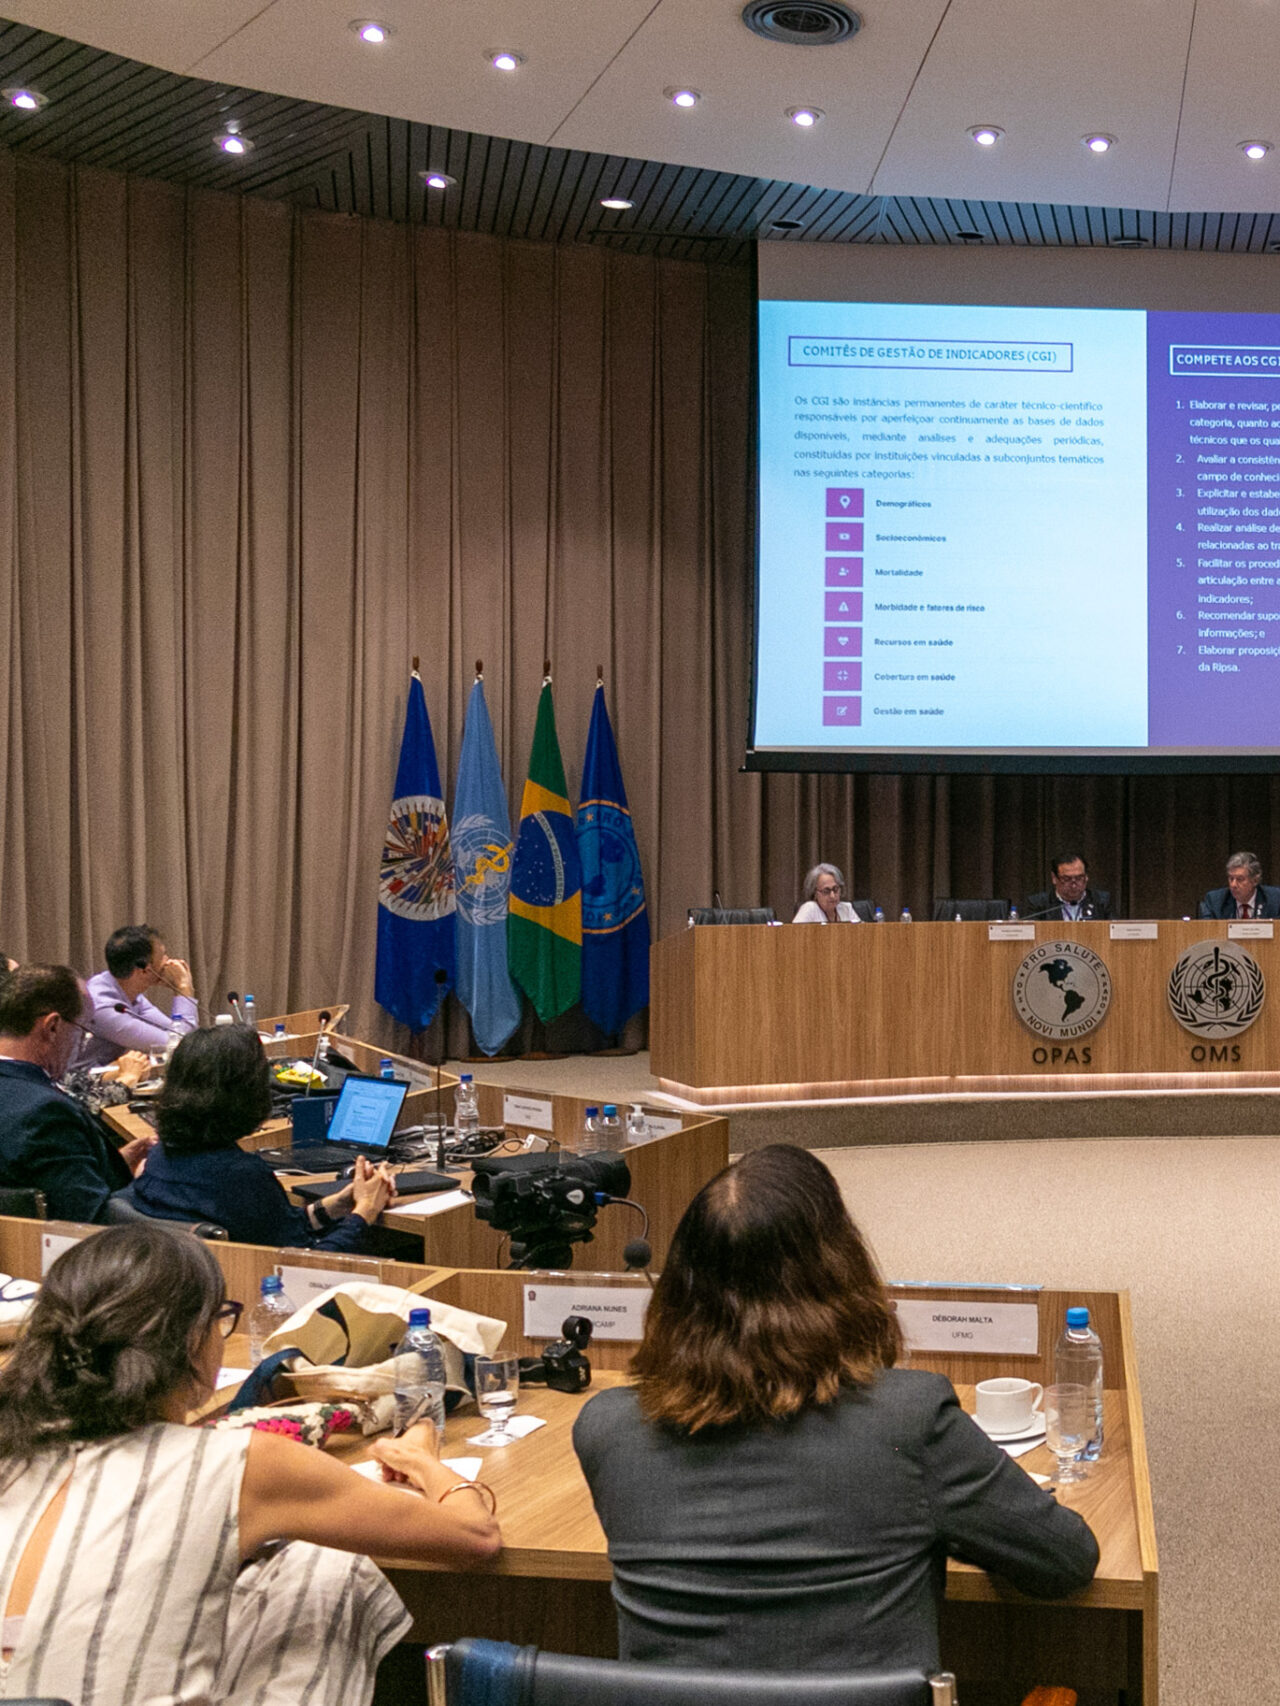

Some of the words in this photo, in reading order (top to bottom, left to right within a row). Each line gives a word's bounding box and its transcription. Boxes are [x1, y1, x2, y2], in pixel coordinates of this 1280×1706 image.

[802, 343, 857, 356] COMITÊS
[859, 346, 874, 357] DE
[877, 345, 926, 358] GESTÃO
[928, 348, 943, 359] DE
[945, 349, 1025, 361] INDICADORES
[1026, 350, 1057, 364] (CGI)
[1176, 353, 1232, 365] COMPETE
[1234, 355, 1259, 366] AOS
[794, 396, 808, 406] Os
[811, 396, 829, 406] CGI
[832, 397, 850, 406] são
[852, 397, 901, 407] instâncias
[904, 399, 966, 410] permanentes
[984, 399, 1018, 408] caráter
[1189, 399, 1227, 409] Elaborar
[1237, 400, 1269, 411] revisar,
[794, 412, 858, 424] responsáveis
[861, 415, 877, 425] por
[881, 413, 934, 425] aperfeiçoar
[938, 414, 1009, 424] continuamente
[1027, 415, 1056, 426] bases
[1075, 416, 1104, 426] dados
[1189, 418, 1235, 430] categoria,
[1236, 419, 1269, 430] quanto
[861, 432, 907, 442] mediante
[917, 433, 957, 442] análises
[985, 433, 1043, 446] adequações
[1189, 434, 1228, 444] técnicos
[1229, 437, 1248, 447] que
[793, 449, 852, 460] constituídas
[855, 452, 871, 462] por
[874, 450, 929, 463] instituições
[931, 451, 982, 462] vinculadas
[992, 452, 1056, 465] subconjuntos
[1058, 453, 1105, 465] temáticos
[1196, 454, 1228, 464] Avaliar
[793, 469, 811, 477] nas
[813, 468, 859, 480] seguintes
[861, 468, 914, 481] categorias:
[1196, 473, 1228, 483] campo
[1197, 487, 1239, 500] Explicitar
[875, 499, 932, 510] Demográficos
[1197, 506, 1241, 518] utilização
[1242, 506, 1260, 516] dos
[1197, 522, 1233, 532] Realizar
[1234, 522, 1267, 532] análise
[875, 533, 947, 543] Socioeconômicos
[1197, 540, 1255, 550] relacionadas
[1197, 557, 1233, 568] Facilitar
[874, 567, 924, 577] Mortalidade
[1197, 575, 1248, 587] articulação
[1249, 576, 1274, 585] entre
[1197, 593, 1253, 605] indicadores;
[874, 602, 918, 612] Morbidade
[926, 603, 955, 612] fatores
[966, 603, 986, 612] risco
[1197, 610, 1256, 620] Recomendar
[874, 638, 912, 647] Recursos
[927, 639, 954, 647] saúde
[1198, 645, 1236, 654] Elaborar
[1212, 661, 1240, 675] Ripsa.
[873, 673, 915, 681] Cobertura
[930, 673, 956, 681] saúde
[873, 706, 903, 716] Gestão
[918, 707, 945, 716] saúde
[1022, 948, 1046, 970] PRO
[1054, 943, 1103, 972] SALUTE
[1026, 1015, 1053, 1036] NOVI
[1060, 1016, 1097, 1037] MUNDI
[1032, 1047, 1092, 1065] OPAS
[1190, 1044, 1242, 1063] OMS
[571, 1304, 602, 1312] ADRIANA
[603, 1305, 627, 1313] NUNES
[932, 1314, 967, 1323] DÉBORAH
[968, 1316, 994, 1324] MALTA
[951, 1331, 974, 1340] UFMG
